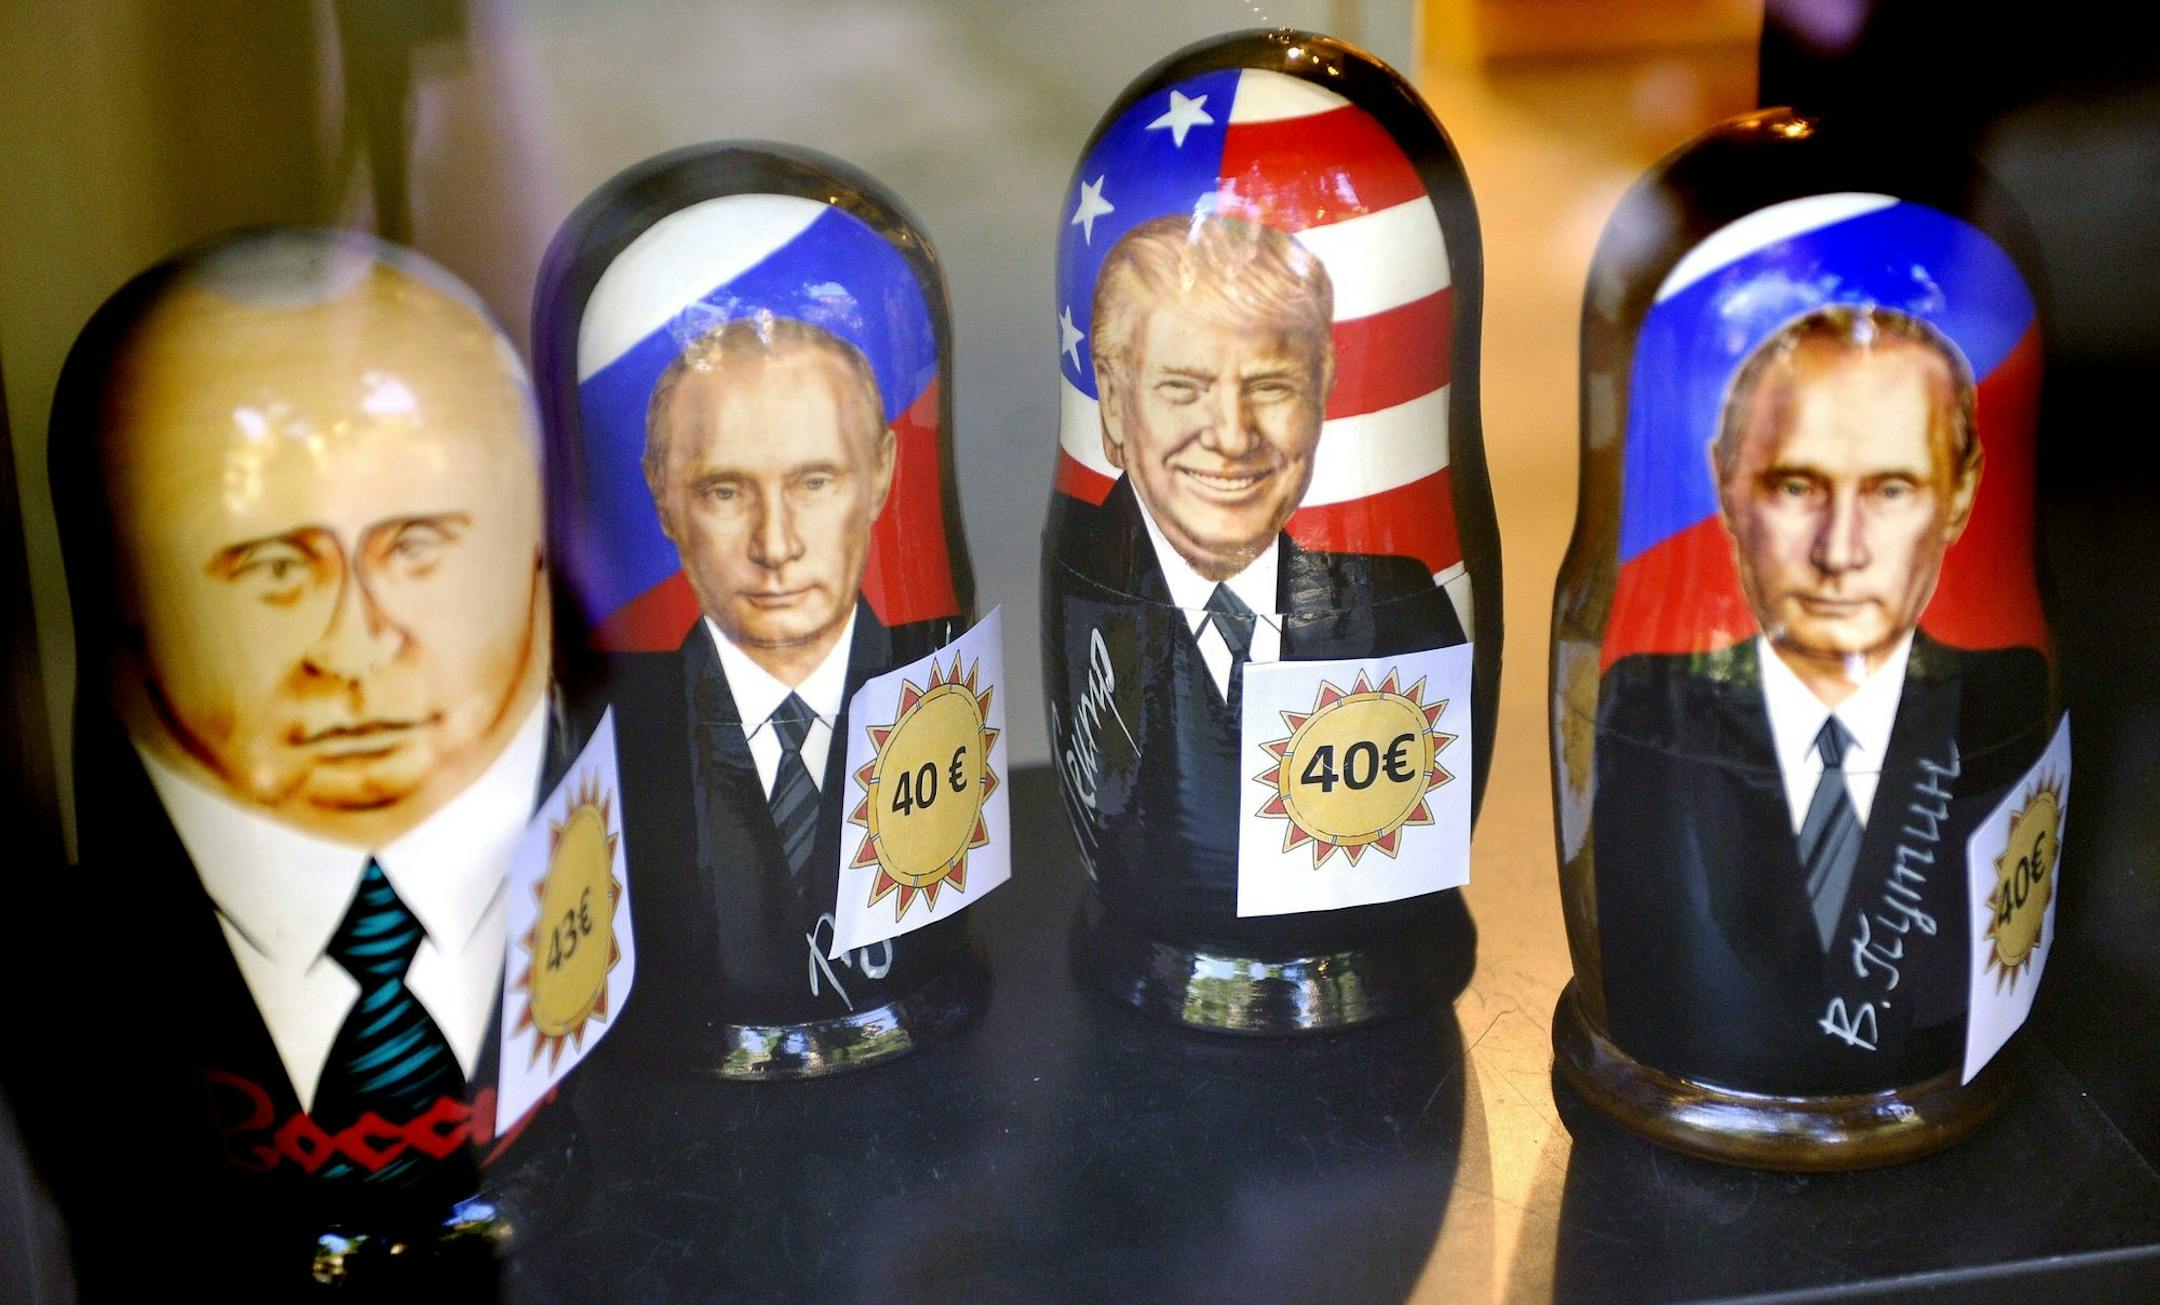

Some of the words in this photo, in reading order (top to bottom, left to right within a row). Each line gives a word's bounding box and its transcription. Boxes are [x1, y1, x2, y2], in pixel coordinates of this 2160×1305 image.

[1300, 733, 1416, 794] 40€
[1997, 831, 2046, 928] 40€
[546, 887, 594, 973] 43€
